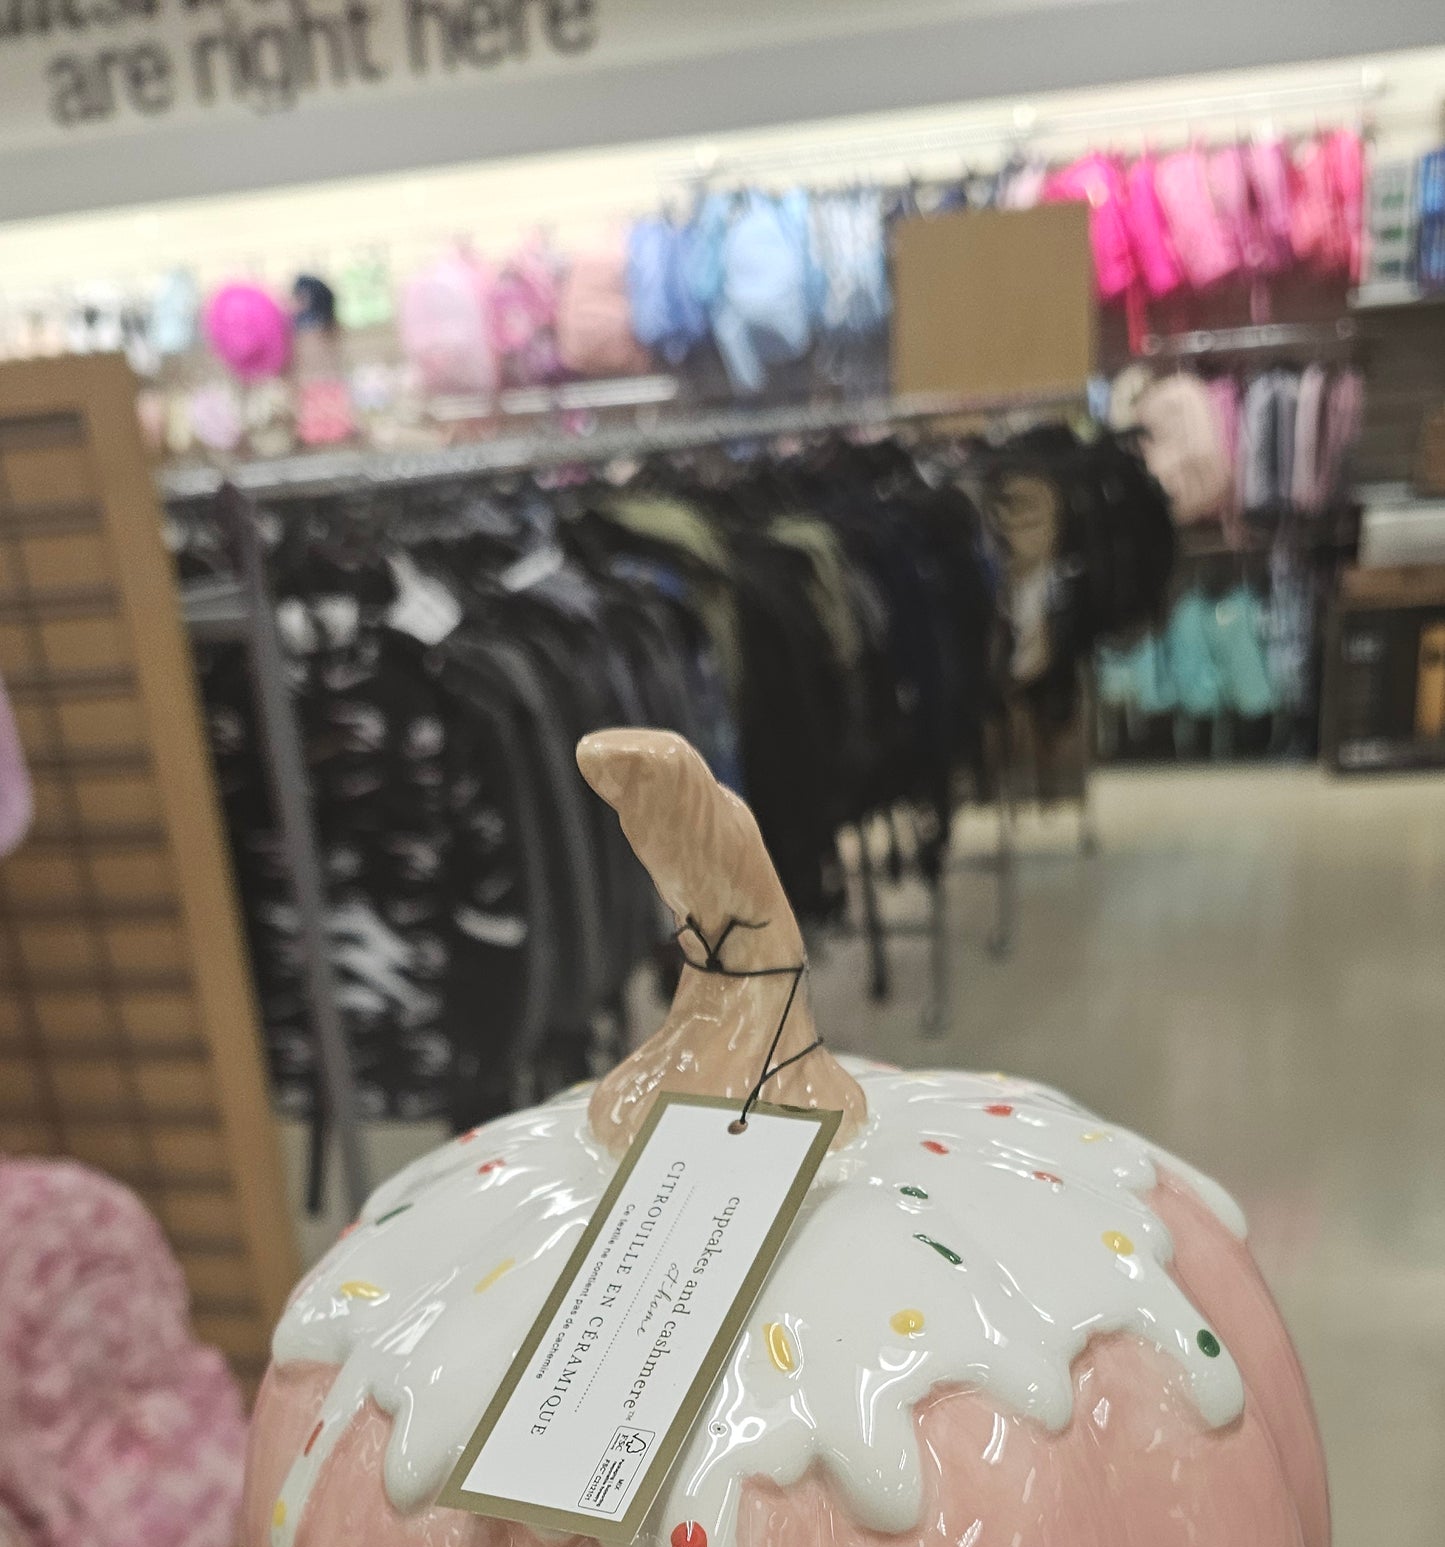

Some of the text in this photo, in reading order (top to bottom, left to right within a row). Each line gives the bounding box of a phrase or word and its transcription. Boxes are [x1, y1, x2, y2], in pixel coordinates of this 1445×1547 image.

[46, 43, 172, 126] are
[191, 2, 388, 116] right
[404, 0, 599, 78] here
[692, 1196, 740, 1274] cupcakes
[530, 1161, 685, 1435] CITROUILLE EN CÉRAMIQUE
[535, 1203, 636, 1379] Ce textile ne contient pas de cachemire
[636, 1288, 672, 1335] home
[671, 1279, 698, 1315] and
[615, 1433, 629, 1451] FSC
